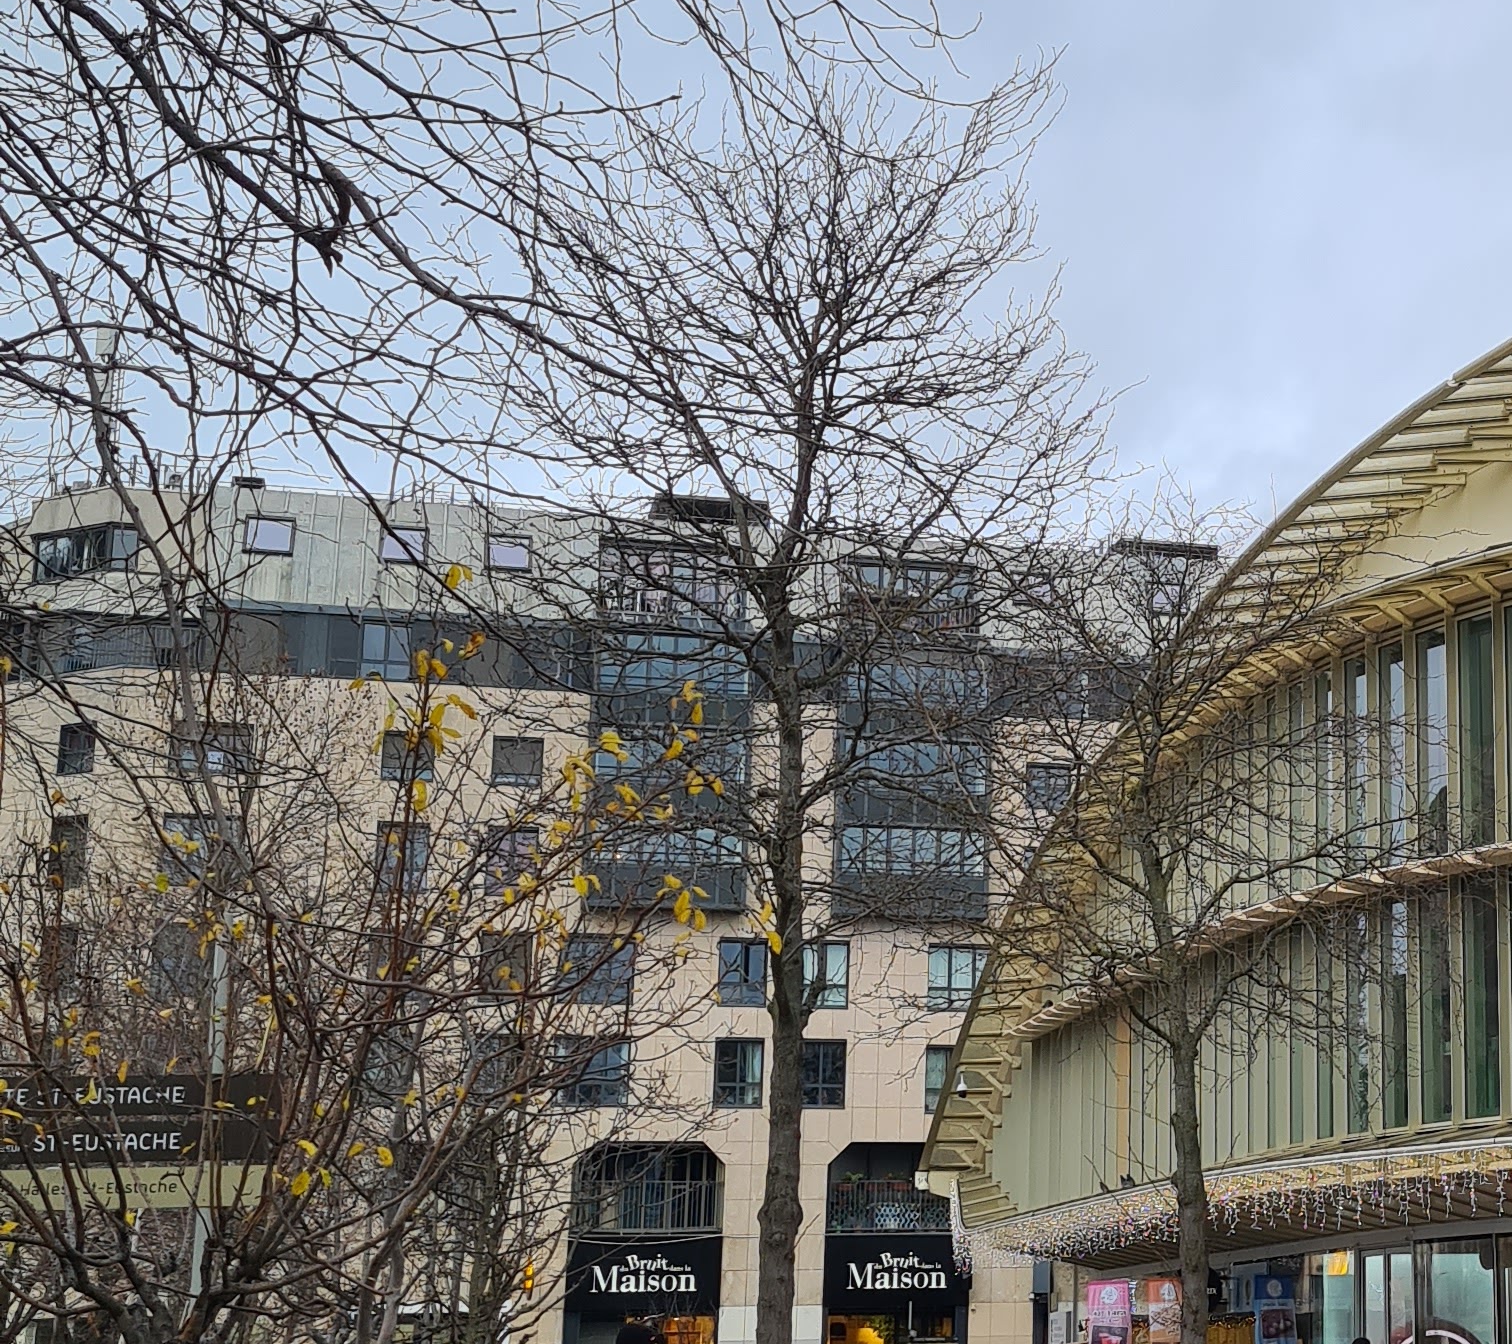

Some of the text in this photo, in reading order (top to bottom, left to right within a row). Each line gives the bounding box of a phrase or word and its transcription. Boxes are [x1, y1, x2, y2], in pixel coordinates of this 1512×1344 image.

[20, 1181, 178, 1196] Hales t-Estache
[625, 1254, 668, 1272] Bruit
[880, 1252, 920, 1268] Bruit
[589, 1265, 697, 1293] Maison
[846, 1262, 947, 1289] Maison
